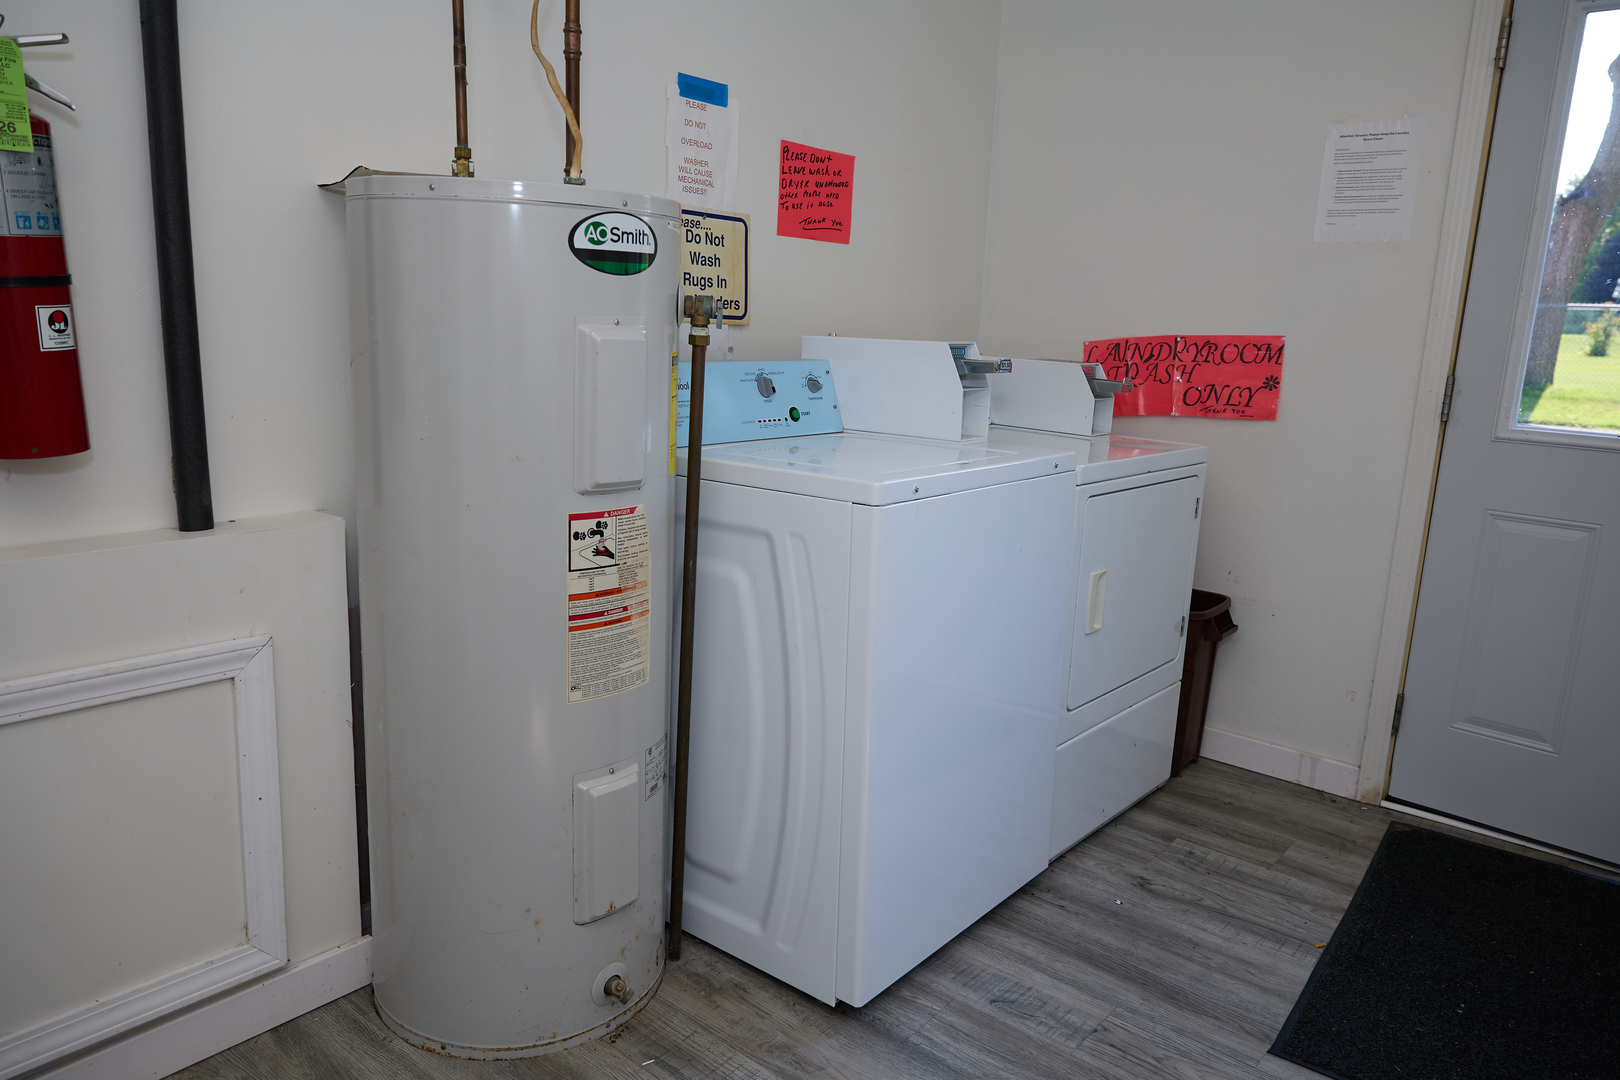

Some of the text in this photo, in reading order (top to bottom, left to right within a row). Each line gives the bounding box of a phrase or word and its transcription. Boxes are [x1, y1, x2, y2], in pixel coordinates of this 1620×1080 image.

[685, 99, 707, 112] PLEASE
[684, 118, 706, 130] DO NOT
[680, 136, 712, 150] OVERLOAD
[684, 156, 709, 168] WASHER
[678, 166, 712, 178] WILL CAUSE
[678, 175, 714, 188] MECHANICAL
[682, 186, 707, 196] ISSUES!!
[686, 228, 725, 248] Do Not
[689, 250, 721, 268] Wash
[683, 272, 727, 290] Rugs In
[1182, 384, 1266, 408] ONLY
